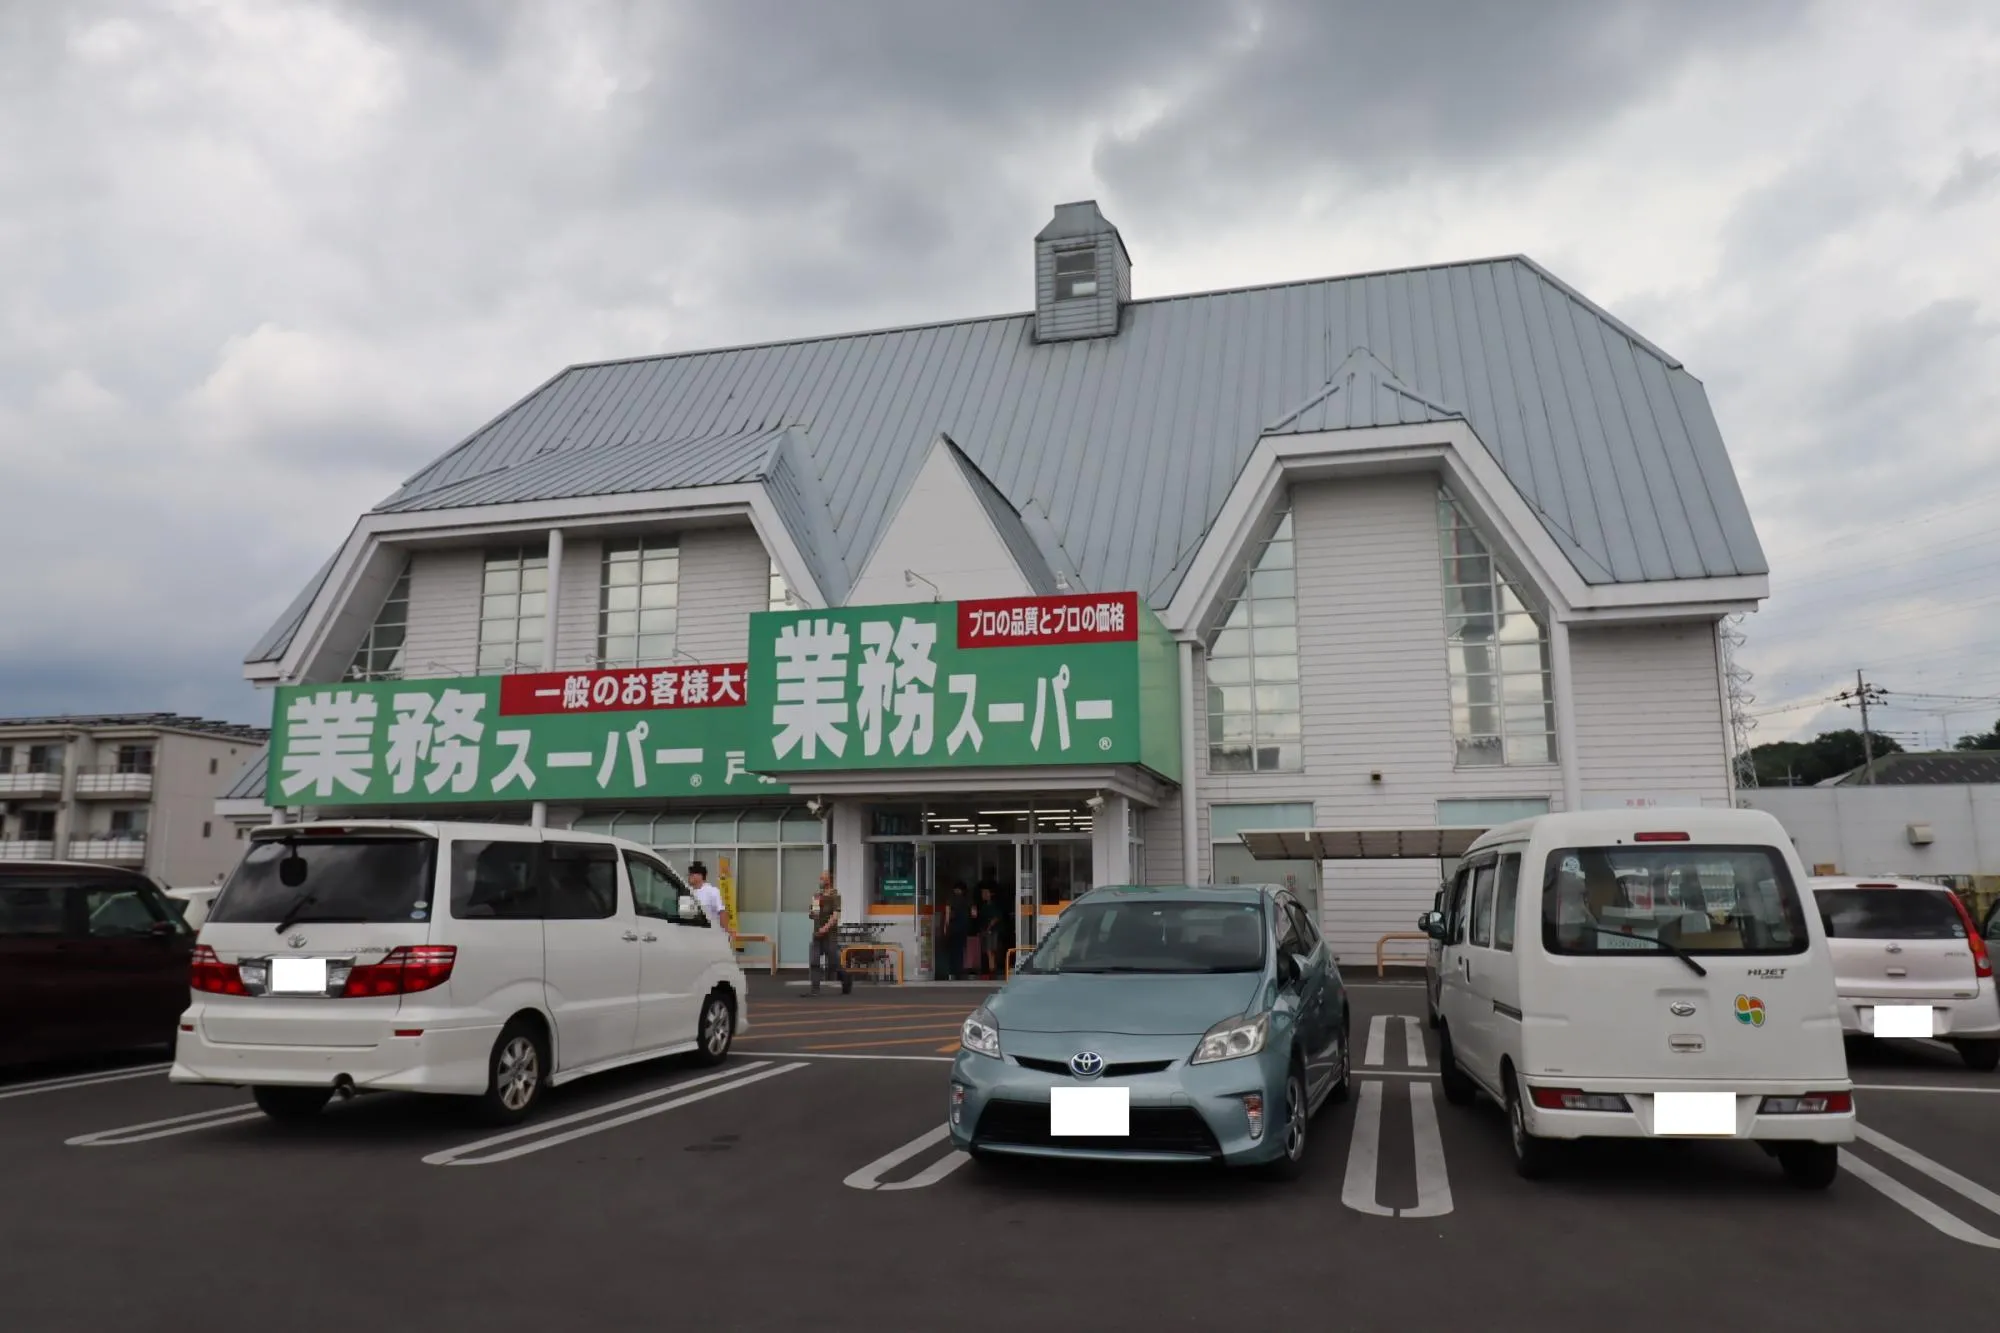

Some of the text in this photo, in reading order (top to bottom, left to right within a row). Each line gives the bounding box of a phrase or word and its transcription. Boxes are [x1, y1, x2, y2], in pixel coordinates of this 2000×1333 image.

[968, 602, 1126, 638] プロの品質とプロの価格
[534, 667, 749, 710] 一般のお客様大
[772, 616, 1114, 761] 業務スーパー
[279, 688, 706, 799] 業務スーパー
[1747, 968, 1787, 976] HIJET
